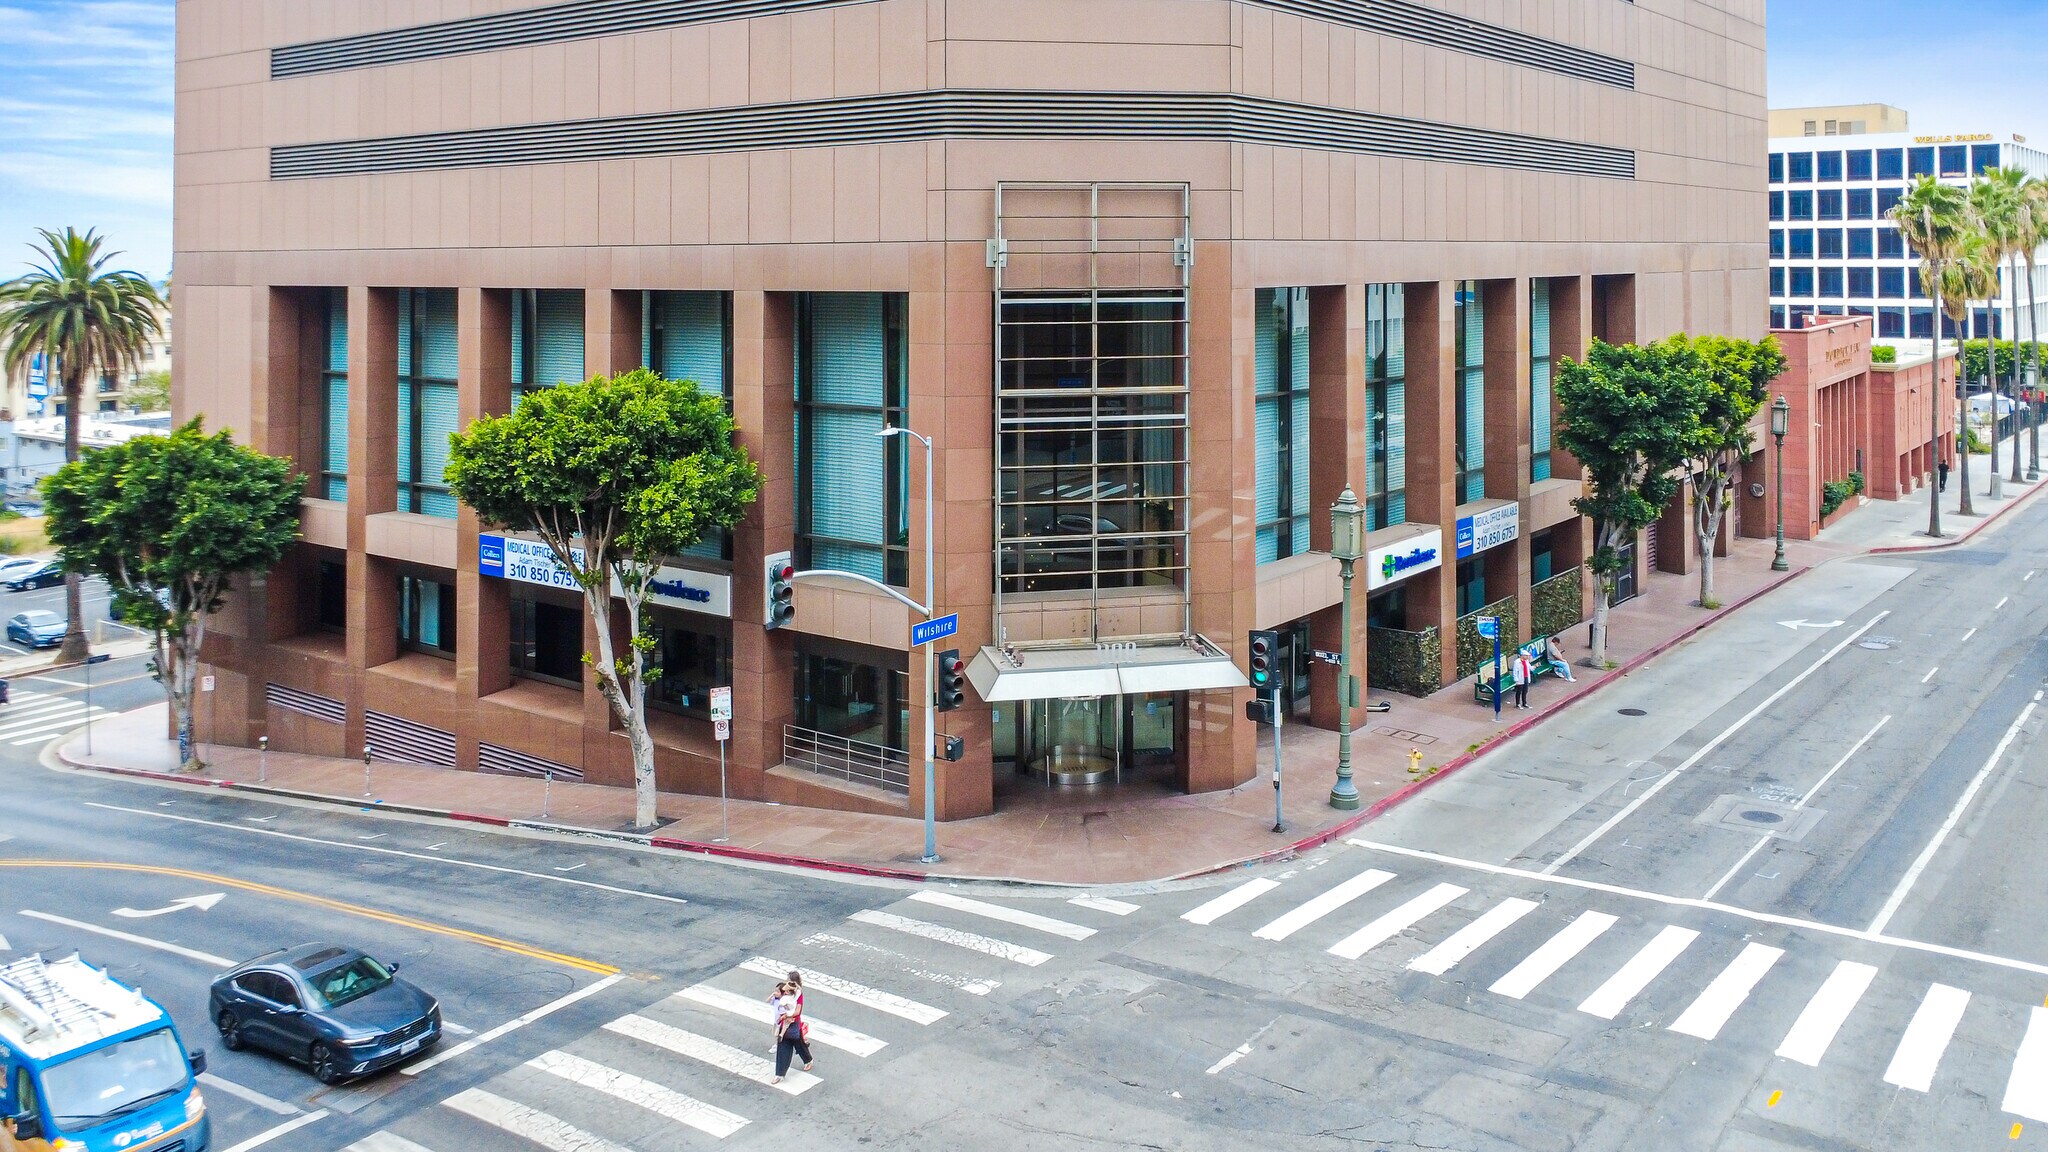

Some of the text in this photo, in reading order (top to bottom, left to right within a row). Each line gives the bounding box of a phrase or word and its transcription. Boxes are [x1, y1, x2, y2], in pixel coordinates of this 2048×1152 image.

[1914, 134, 1993, 143] WELLS FARGO
[1475, 516, 1489, 527] MEDICAL
[1490, 511, 1500, 523] OFFICE
[1476, 525, 1515, 549] 310 850 6757
[507, 541, 530, 555] MEDICAL
[532, 545, 551, 558] OFFICE
[510, 563, 577, 587] 310 850 6757
[917, 621, 952, 640] Wilshire
